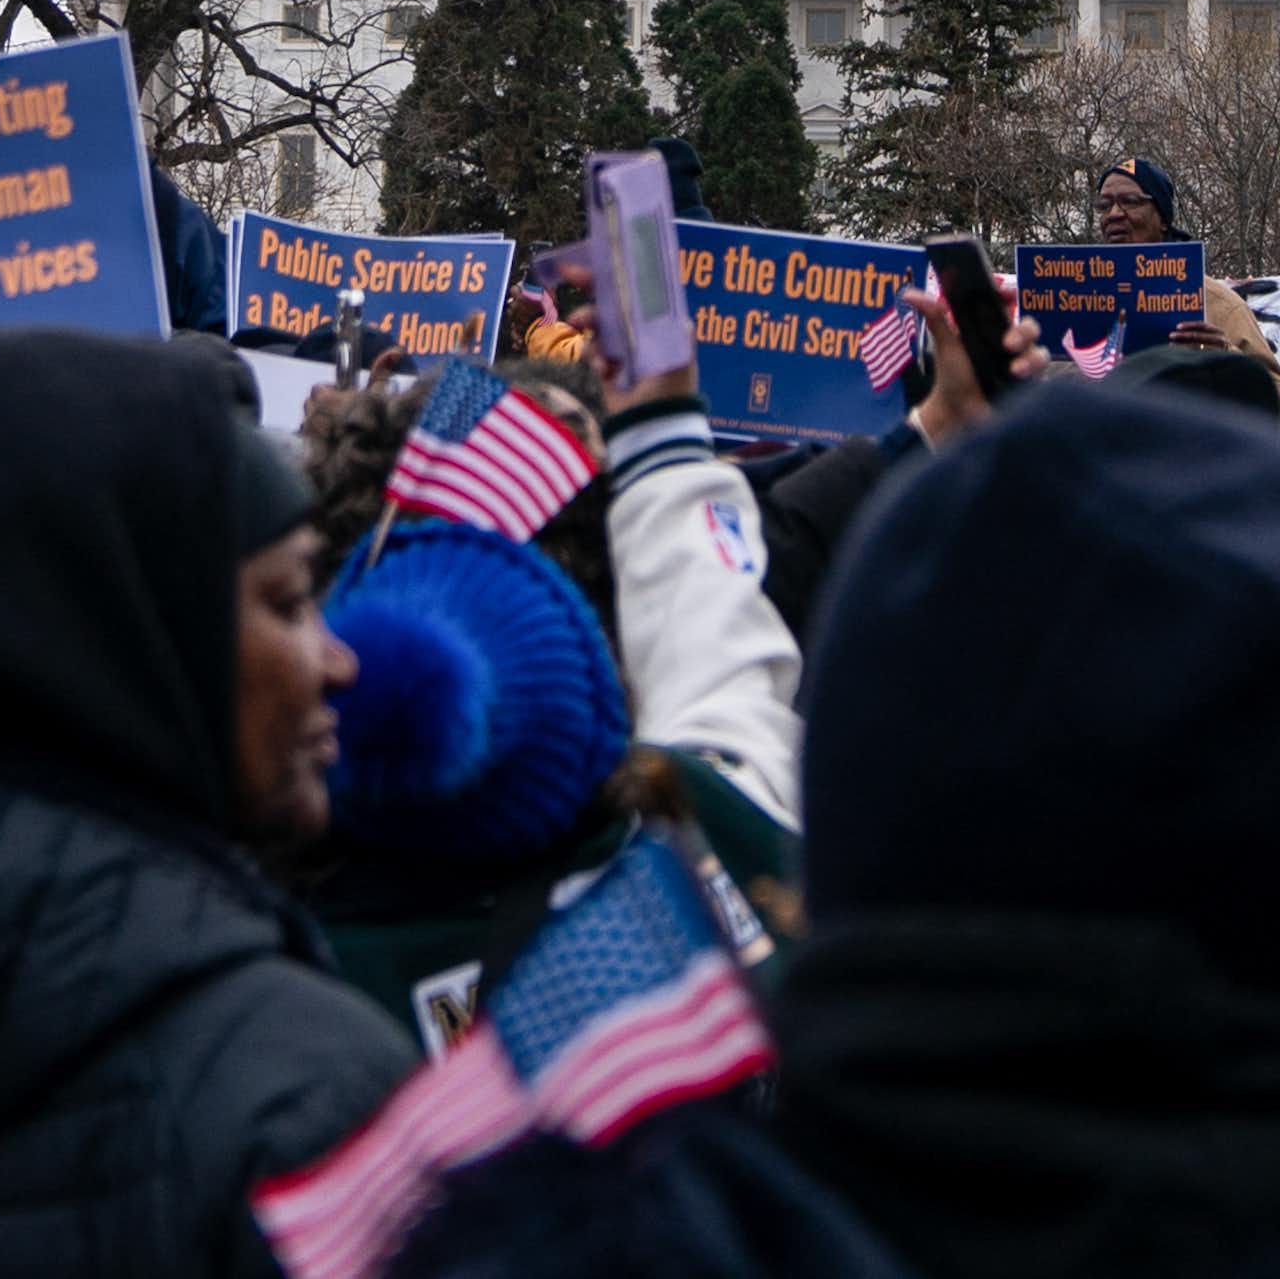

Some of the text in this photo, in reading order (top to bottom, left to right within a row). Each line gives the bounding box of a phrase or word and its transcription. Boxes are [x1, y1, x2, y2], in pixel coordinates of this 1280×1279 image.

[259, 228, 487, 293] Public Service is
[723, 244, 776, 296] the
[1033, 255, 1115, 283] Saving the
[1135, 253, 1187, 282] Saving
[1022, 289, 1116, 311] Civil Service
[1136, 288, 1203, 312] America!
[246, 294, 263, 325] a
[399, 311, 486, 354] Hono!
[696, 305, 738, 345] the
[743, 309, 799, 352] Civil
